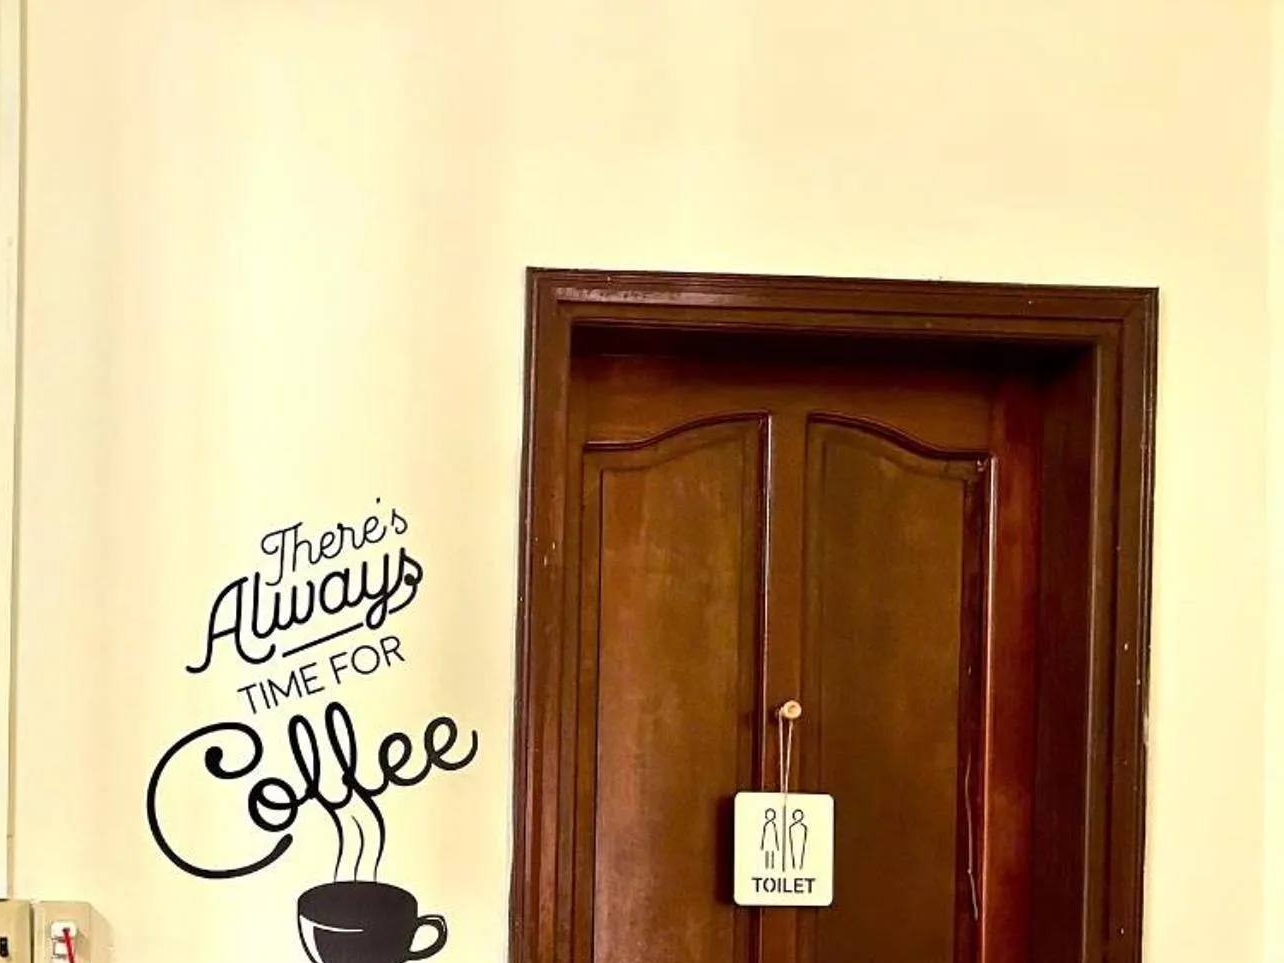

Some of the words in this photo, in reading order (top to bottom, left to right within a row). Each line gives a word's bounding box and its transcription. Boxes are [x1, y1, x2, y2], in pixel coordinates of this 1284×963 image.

[260, 497, 409, 587] There's
[185, 546, 424, 675] Always
[236, 661, 326, 715] TIME
[328, 635, 406, 685] FOR
[146, 700, 479, 880] Coffee
[751, 877, 816, 894] TOILET
